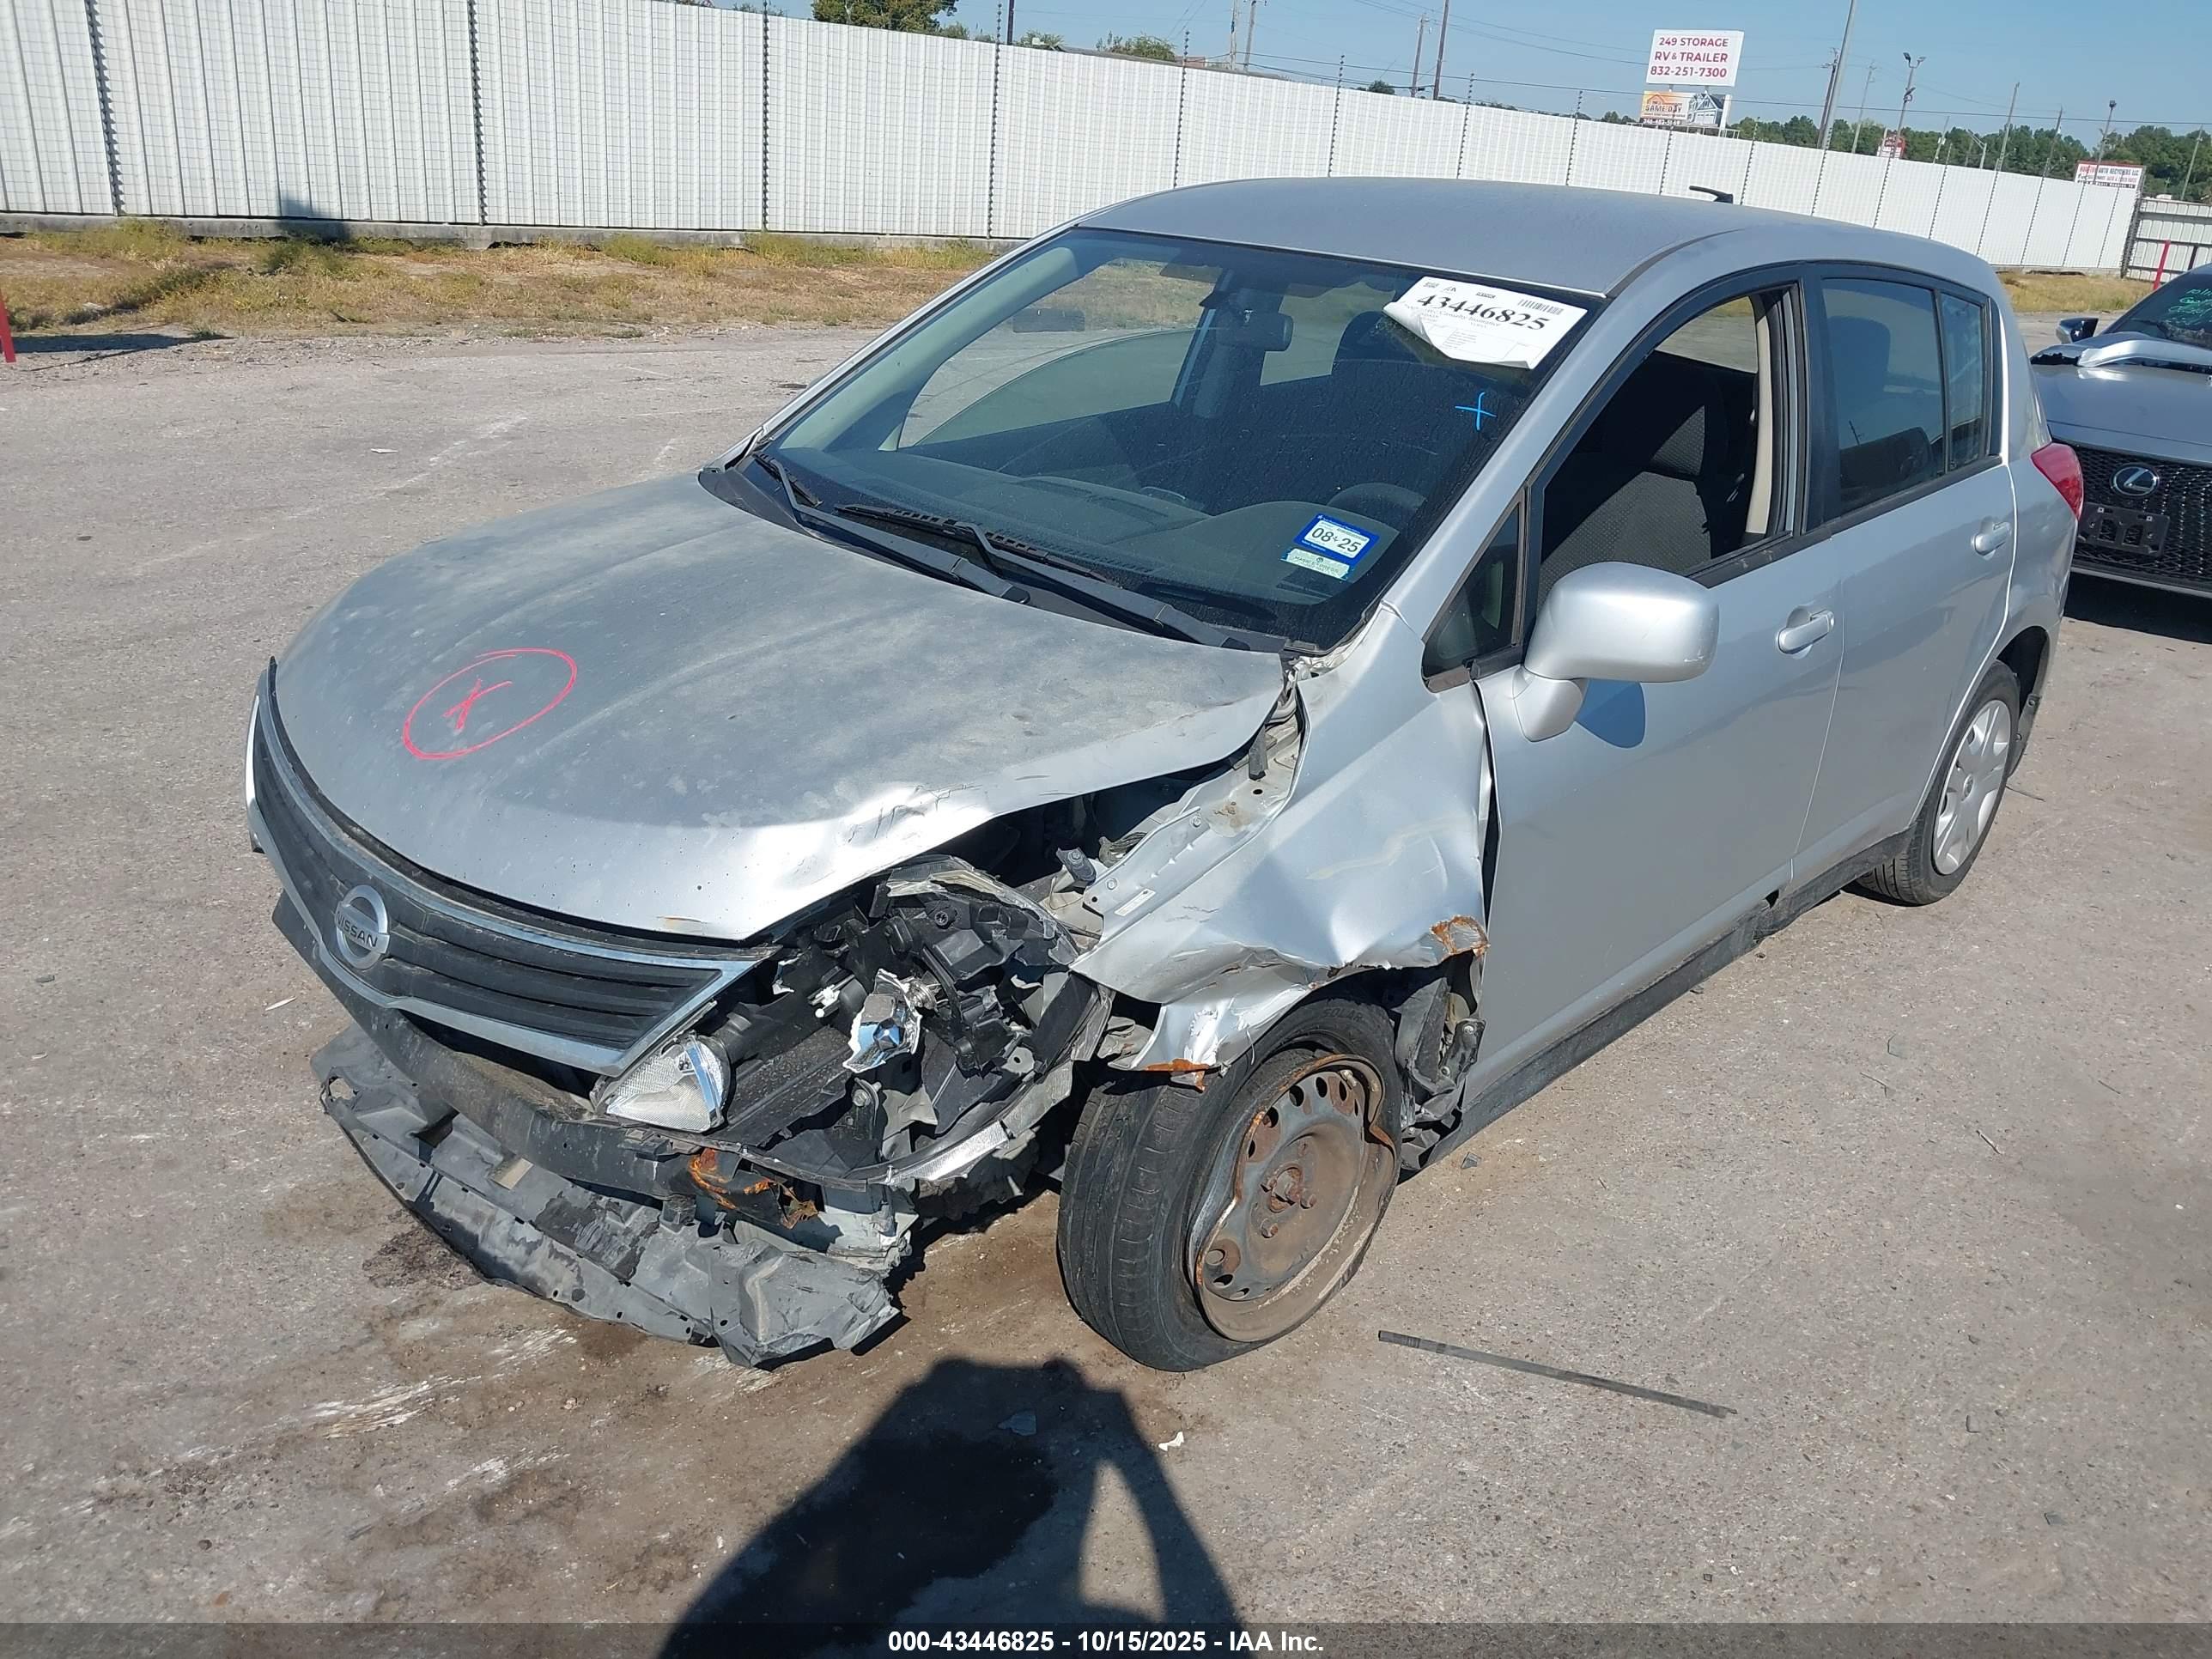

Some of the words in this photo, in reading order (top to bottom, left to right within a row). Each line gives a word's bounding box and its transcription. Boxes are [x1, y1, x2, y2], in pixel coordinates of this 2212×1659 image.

[1659, 37, 1678, 46] 249
[1680, 38, 1729, 47] STORAGE
[1655, 52, 1671, 61] RV
[1680, 52, 1729, 63] TRAILER
[1650, 66, 1728, 77] 832-251-7300
[1417, 294, 1553, 331] 43446825
[1311, 527, 1334, 543] 08
[1338, 538, 1361, 553] 25
[336, 911, 379, 947] NISSAN
